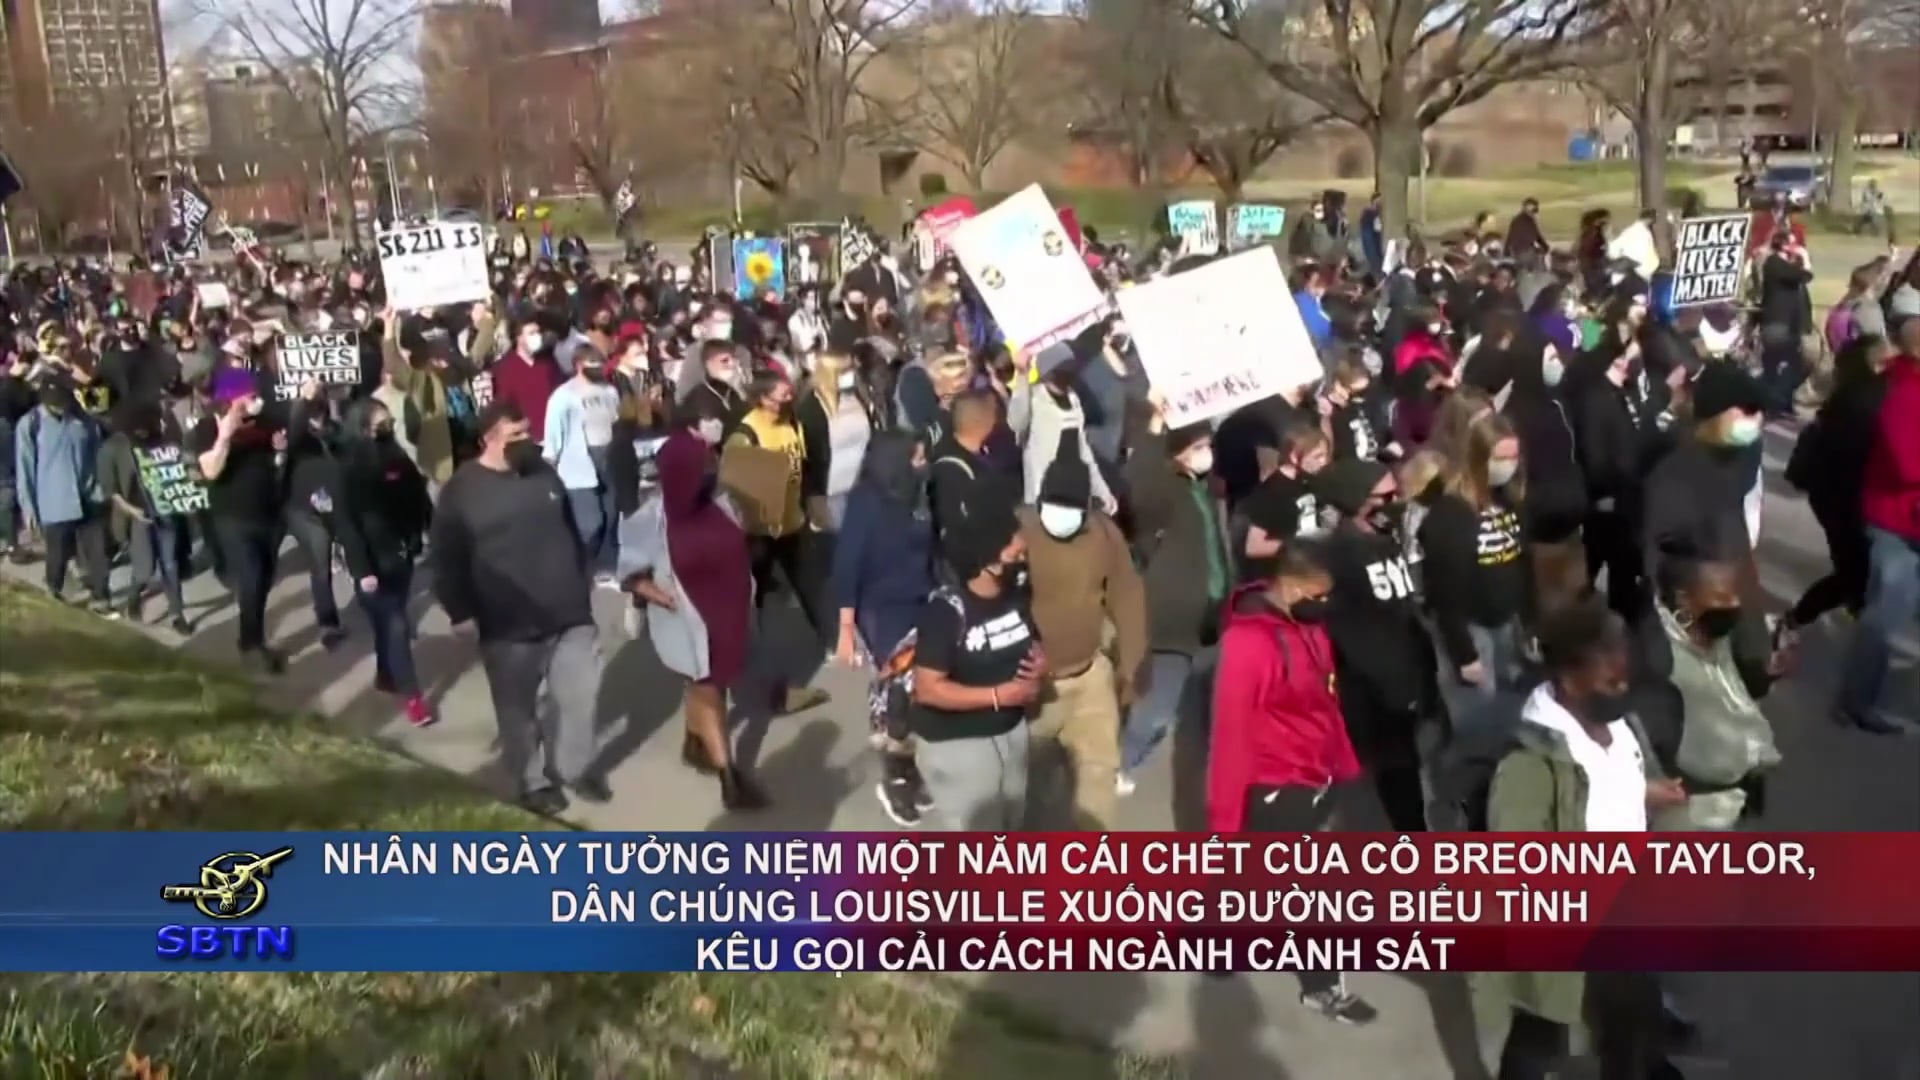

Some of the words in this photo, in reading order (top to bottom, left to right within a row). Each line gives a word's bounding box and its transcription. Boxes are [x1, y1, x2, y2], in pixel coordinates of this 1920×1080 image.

[454, 226, 481, 248] IS
[1685, 221, 1745, 248] BLACK
[1684, 246, 1737, 273] LIVES
[1675, 273, 1737, 302] MATTER
[285, 333, 348, 348] BLACK
[284, 347, 353, 367] LIVES
[284, 368, 357, 384] MATTER
